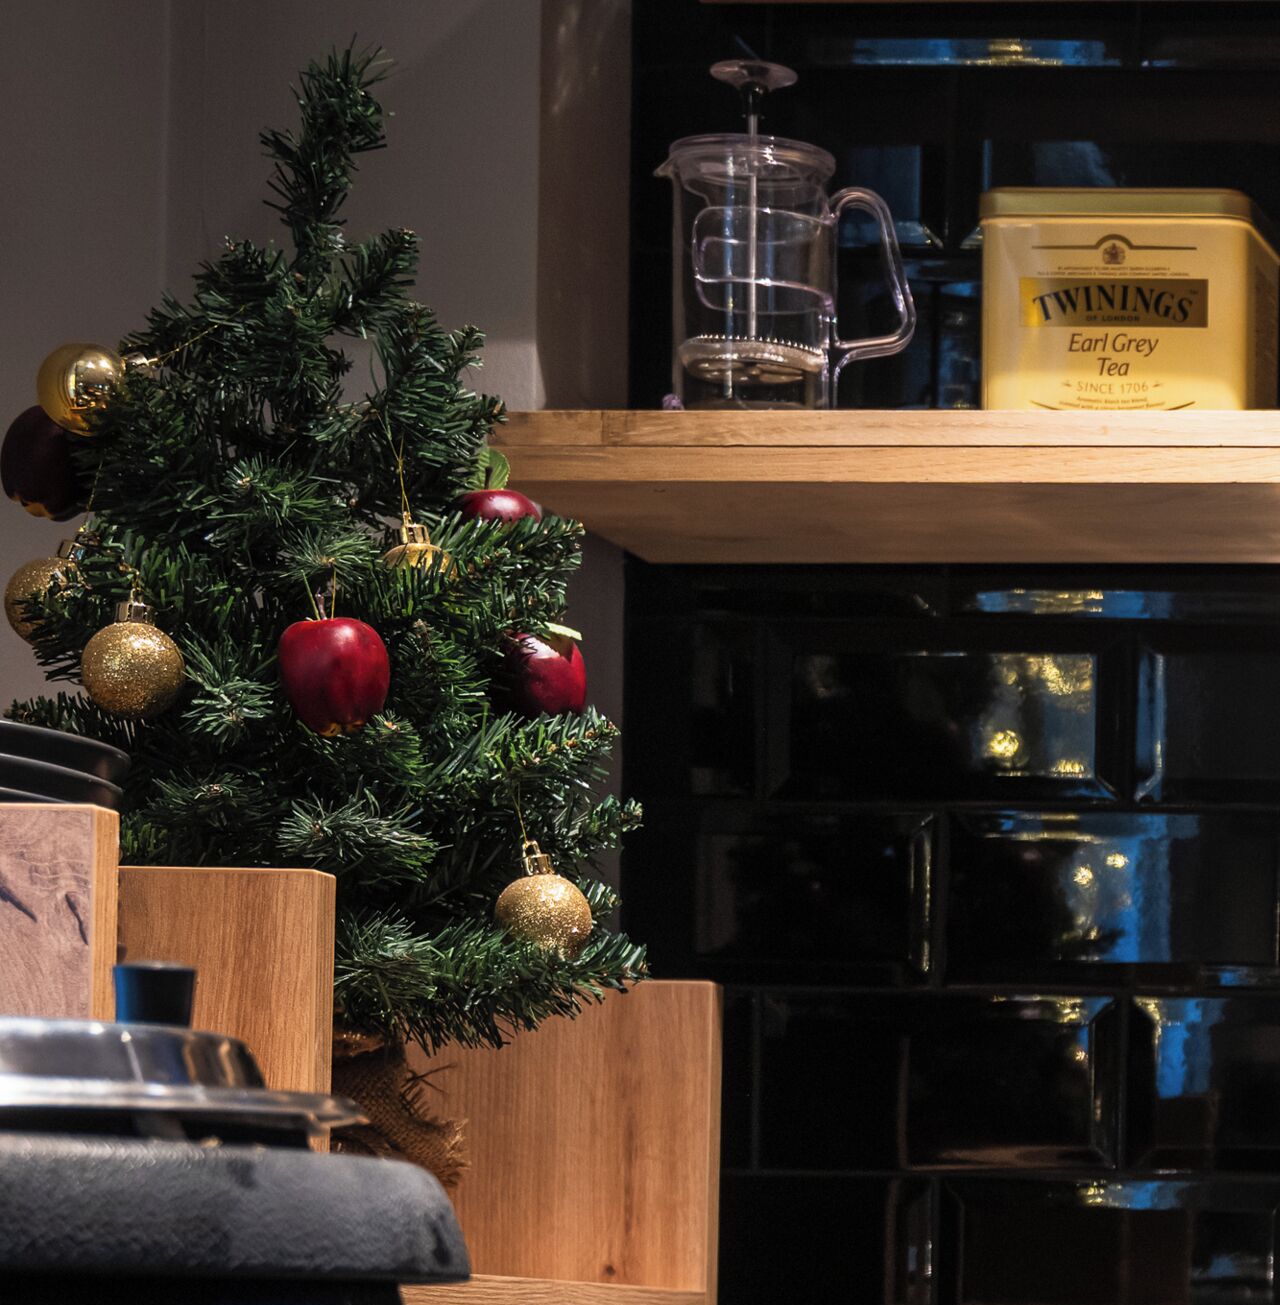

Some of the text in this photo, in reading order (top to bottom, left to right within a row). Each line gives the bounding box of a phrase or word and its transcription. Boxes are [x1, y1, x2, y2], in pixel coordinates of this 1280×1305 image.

[1032, 284, 1193, 323] TWININGS
[1068, 332, 1160, 358] Earl Grey
[1097, 357, 1130, 377] Tea
[1077, 381, 1149, 394] SINCE 1706
